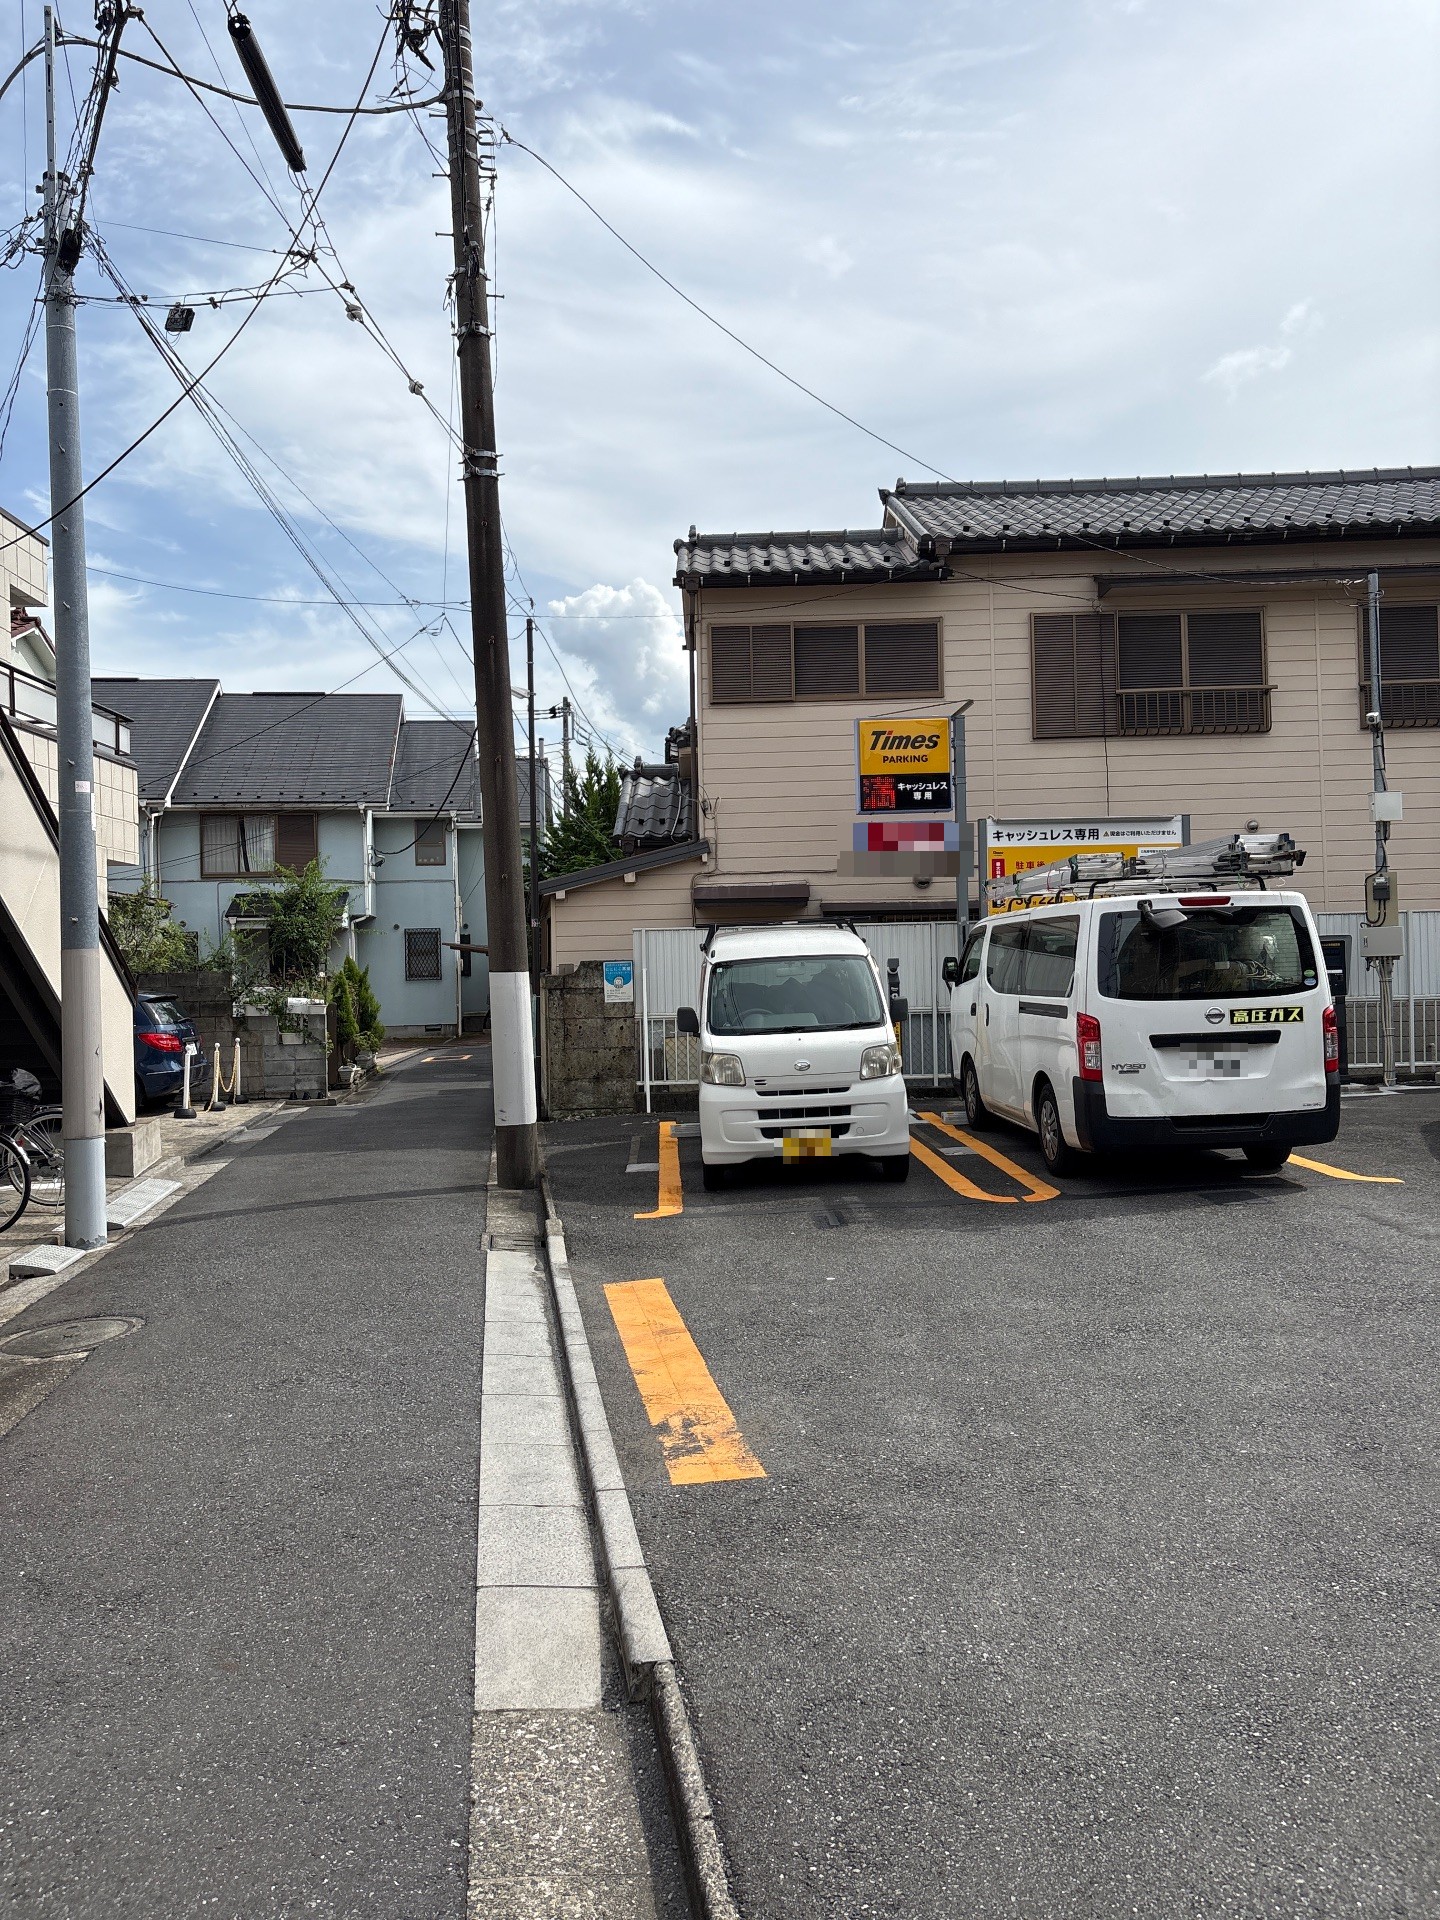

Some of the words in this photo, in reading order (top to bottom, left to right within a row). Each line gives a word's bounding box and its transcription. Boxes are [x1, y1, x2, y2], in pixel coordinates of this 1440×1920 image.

[869, 730, 941, 751] Times
[882, 754, 929, 764] PARKING
[897, 781, 948, 791] キャッシュレス
[992, 828, 1100, 842] キャッシュレス専用
[1232, 1007, 1302, 1023] 高圧ガス
[1111, 1062, 1147, 1071] NV350
